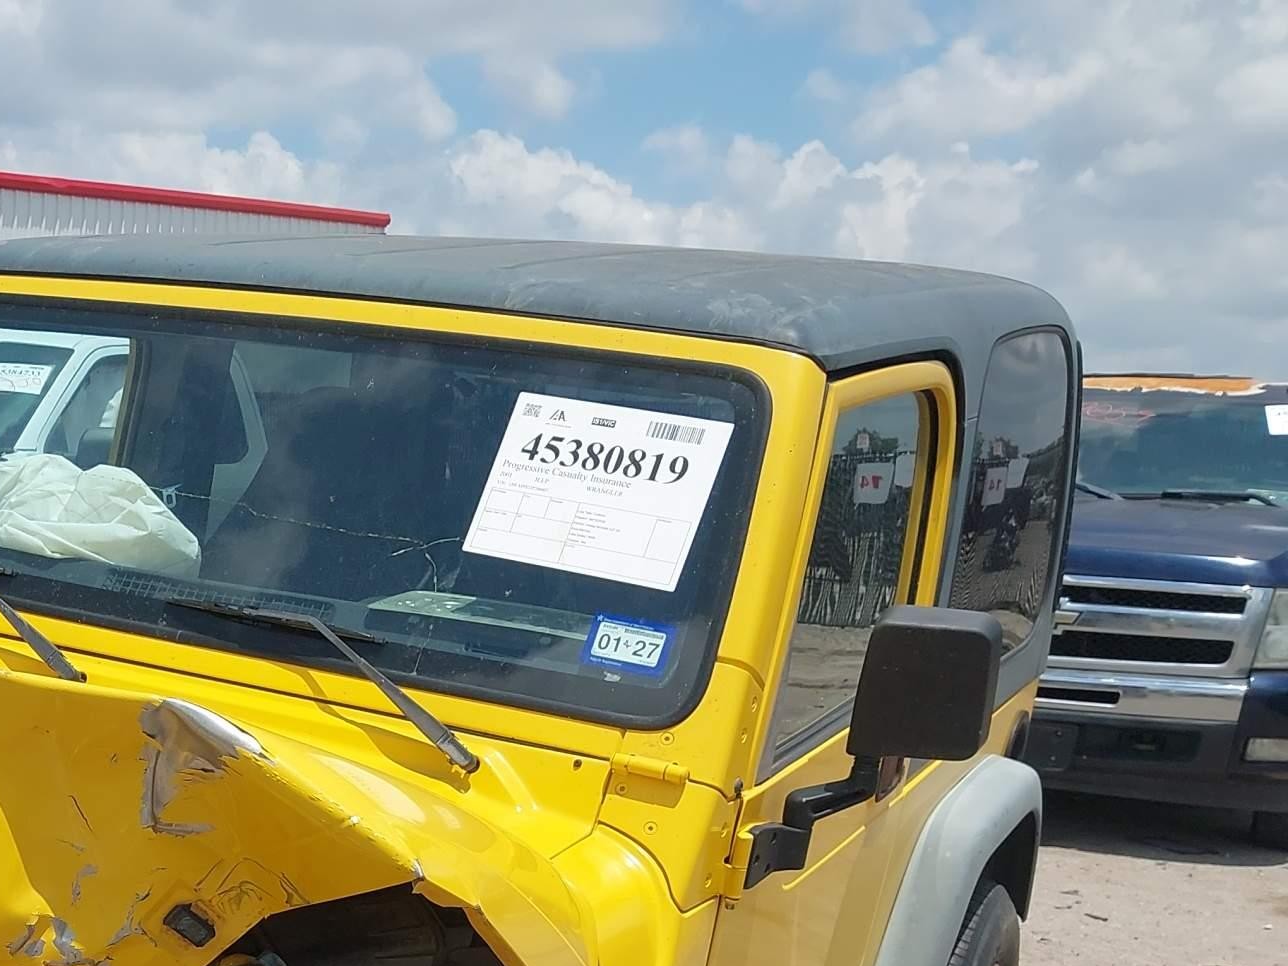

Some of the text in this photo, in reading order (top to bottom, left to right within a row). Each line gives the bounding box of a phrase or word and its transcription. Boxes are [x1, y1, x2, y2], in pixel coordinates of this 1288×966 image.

[502, 458, 632, 489] Progressive Casualty Insurance
[521, 432, 690, 485] 45380819
[598, 633, 622, 653] 01
[631, 640, 661, 659] 27
